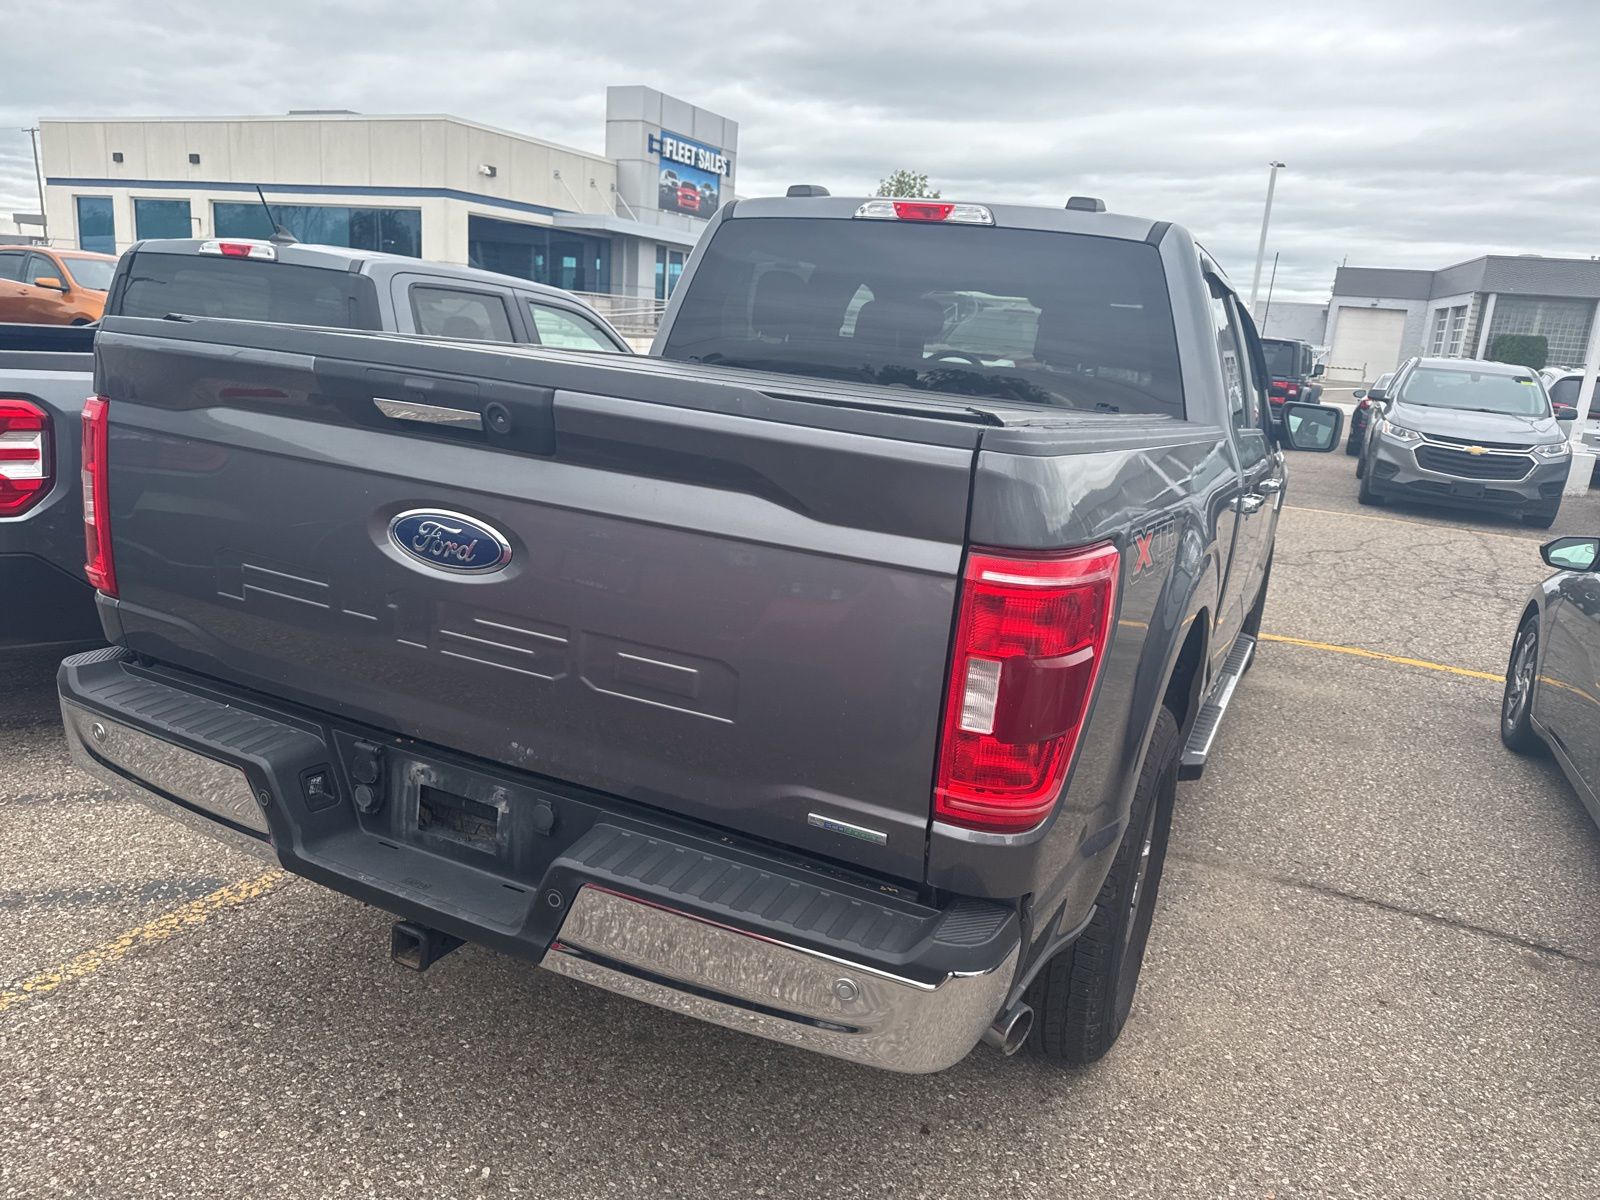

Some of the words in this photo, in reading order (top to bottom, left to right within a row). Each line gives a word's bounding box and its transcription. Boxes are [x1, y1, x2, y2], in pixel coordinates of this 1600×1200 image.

[665, 138, 698, 166] FLEET
[698, 148, 728, 176] SALES
[411, 520, 478, 562] Ford
